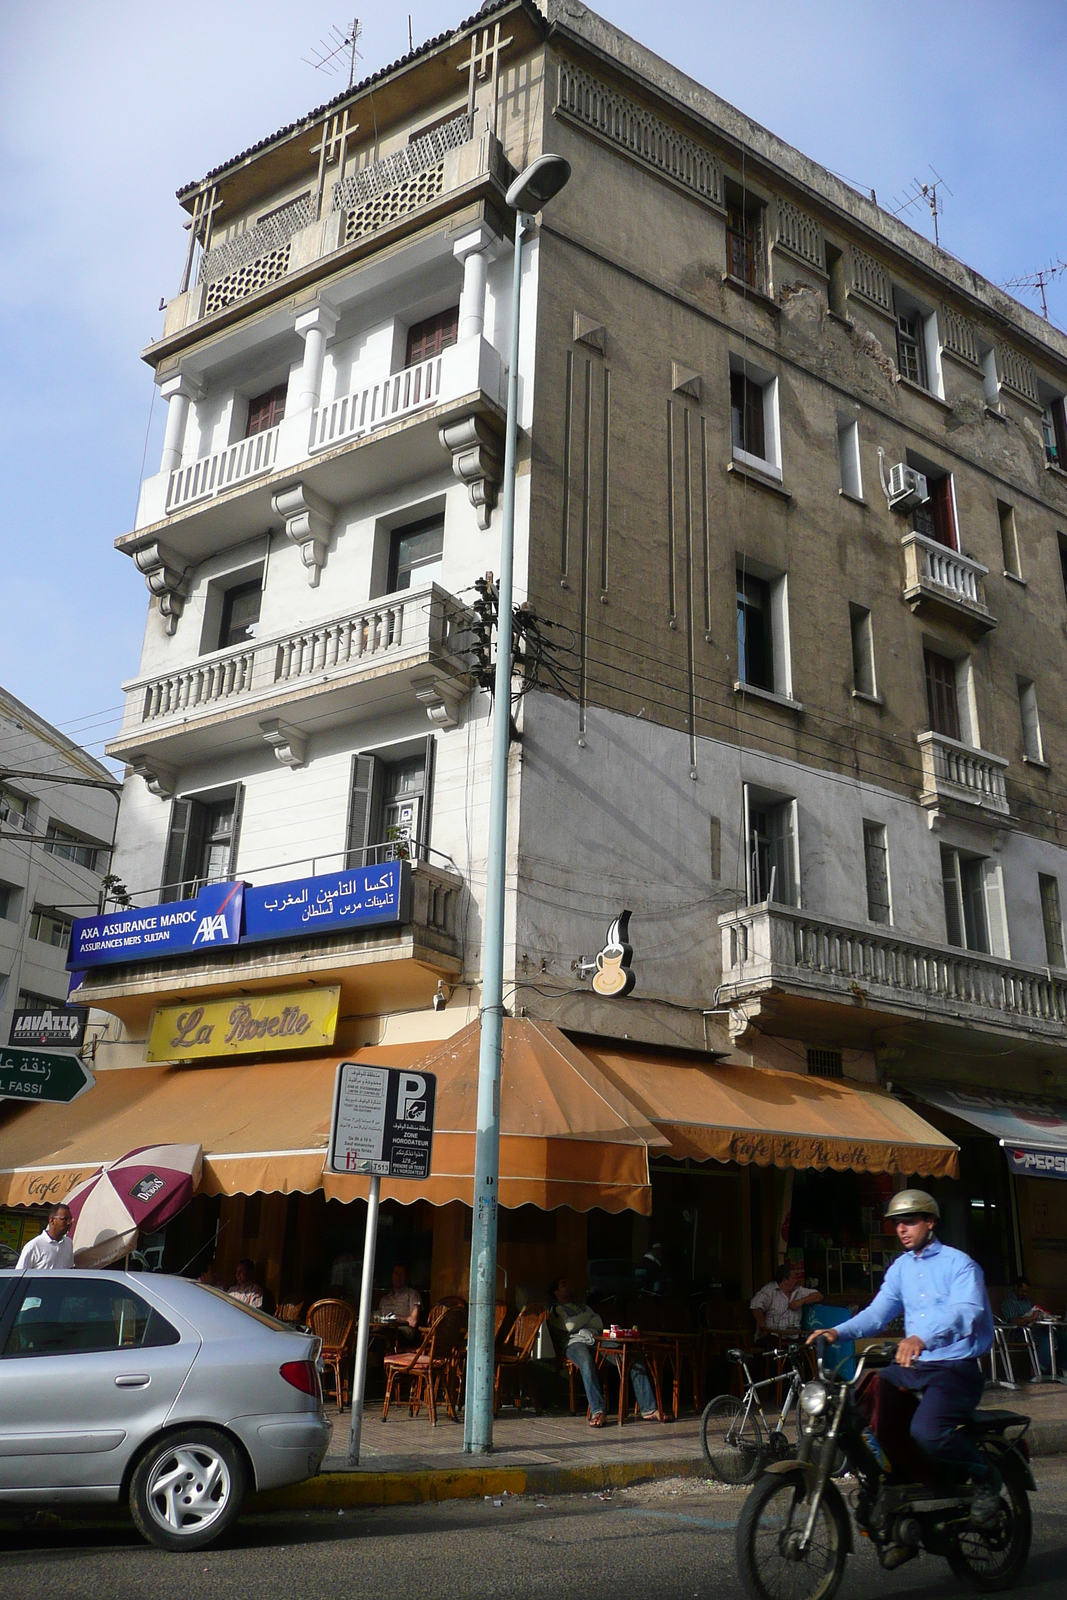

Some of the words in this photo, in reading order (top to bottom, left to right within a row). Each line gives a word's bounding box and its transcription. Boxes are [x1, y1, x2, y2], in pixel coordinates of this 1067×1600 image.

[316, 880, 357, 904] التأمين
[364, 871, 394, 892] أكسا
[264, 888, 309, 912] المغرب
[339, 901, 362, 915] مرس
[364, 892, 394, 908] تأمينات
[80, 927, 100, 940] AXA
[102, 917, 158, 937] ASSURANCE
[160, 910, 198, 927] MAROC
[192, 914, 229, 945] AXA
[80, 938, 123, 953] ASSURANCES
[123, 937, 142, 946] MERS
[143, 931, 170, 943] SULTAN
[14, 1010, 80, 1031] LAVAZZA
[170, 1006, 216, 1048] La
[224, 1002, 314, 1044] Rosette
[20, 1057, 52, 1081] زنقة
[8, 1081, 43, 1094] FASSI
[396, 1072, 427, 1120] P
[392, 1138, 429, 1146] HORODATEUR
[776, 1140, 801, 1159] La
[806, 1139, 872, 1165] Rosette
[137, 1178, 164, 1201] DUBOIS
